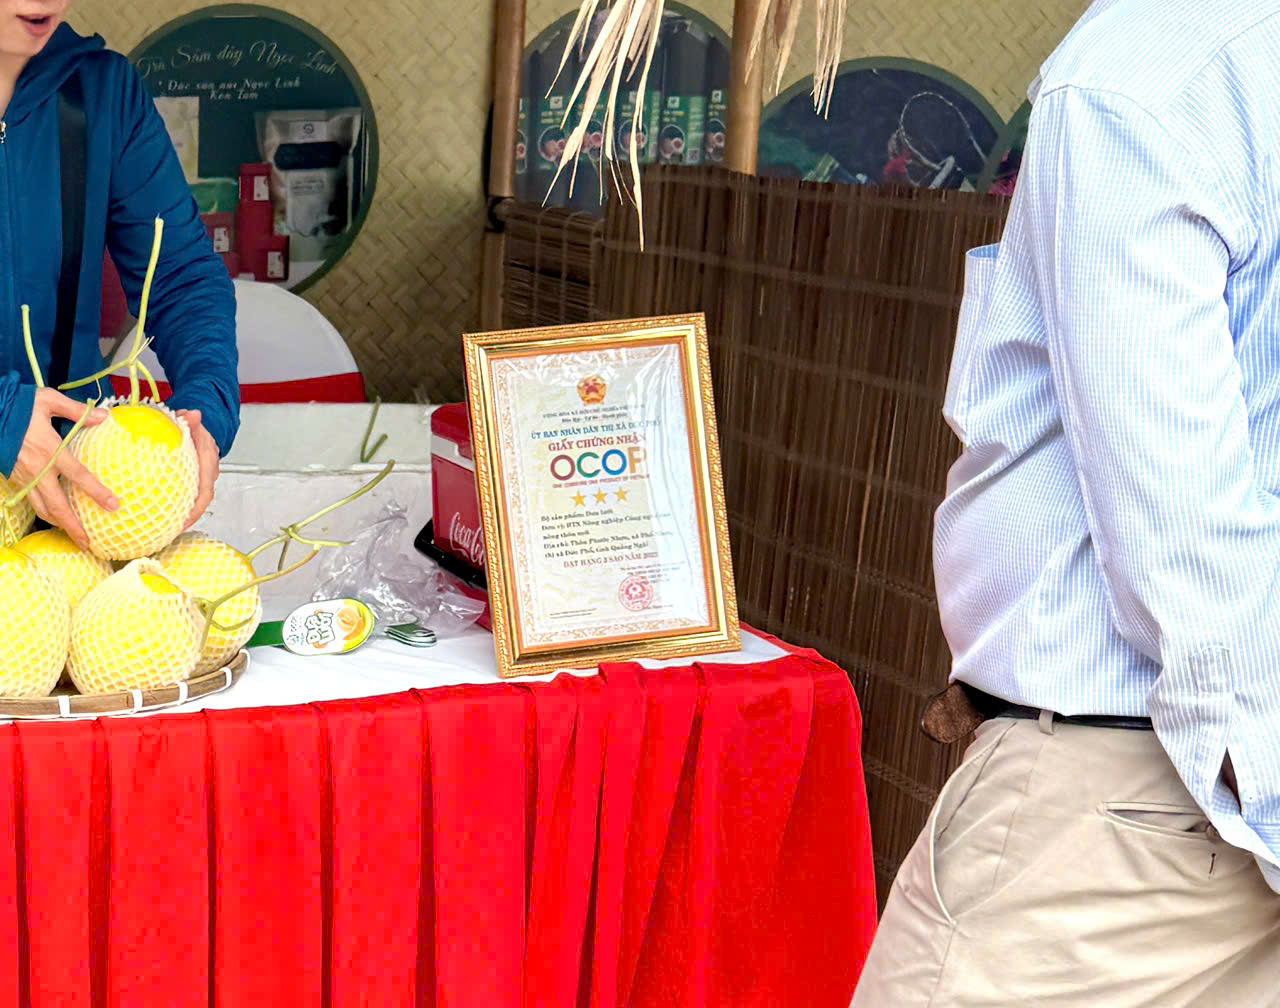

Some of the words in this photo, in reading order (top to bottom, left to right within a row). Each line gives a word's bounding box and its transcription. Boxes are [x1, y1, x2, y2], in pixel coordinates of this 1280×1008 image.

[548, 438, 574, 452] GIẤY
[576, 437, 615, 449] CHỨNG
[550, 446, 648, 481] OCOP
